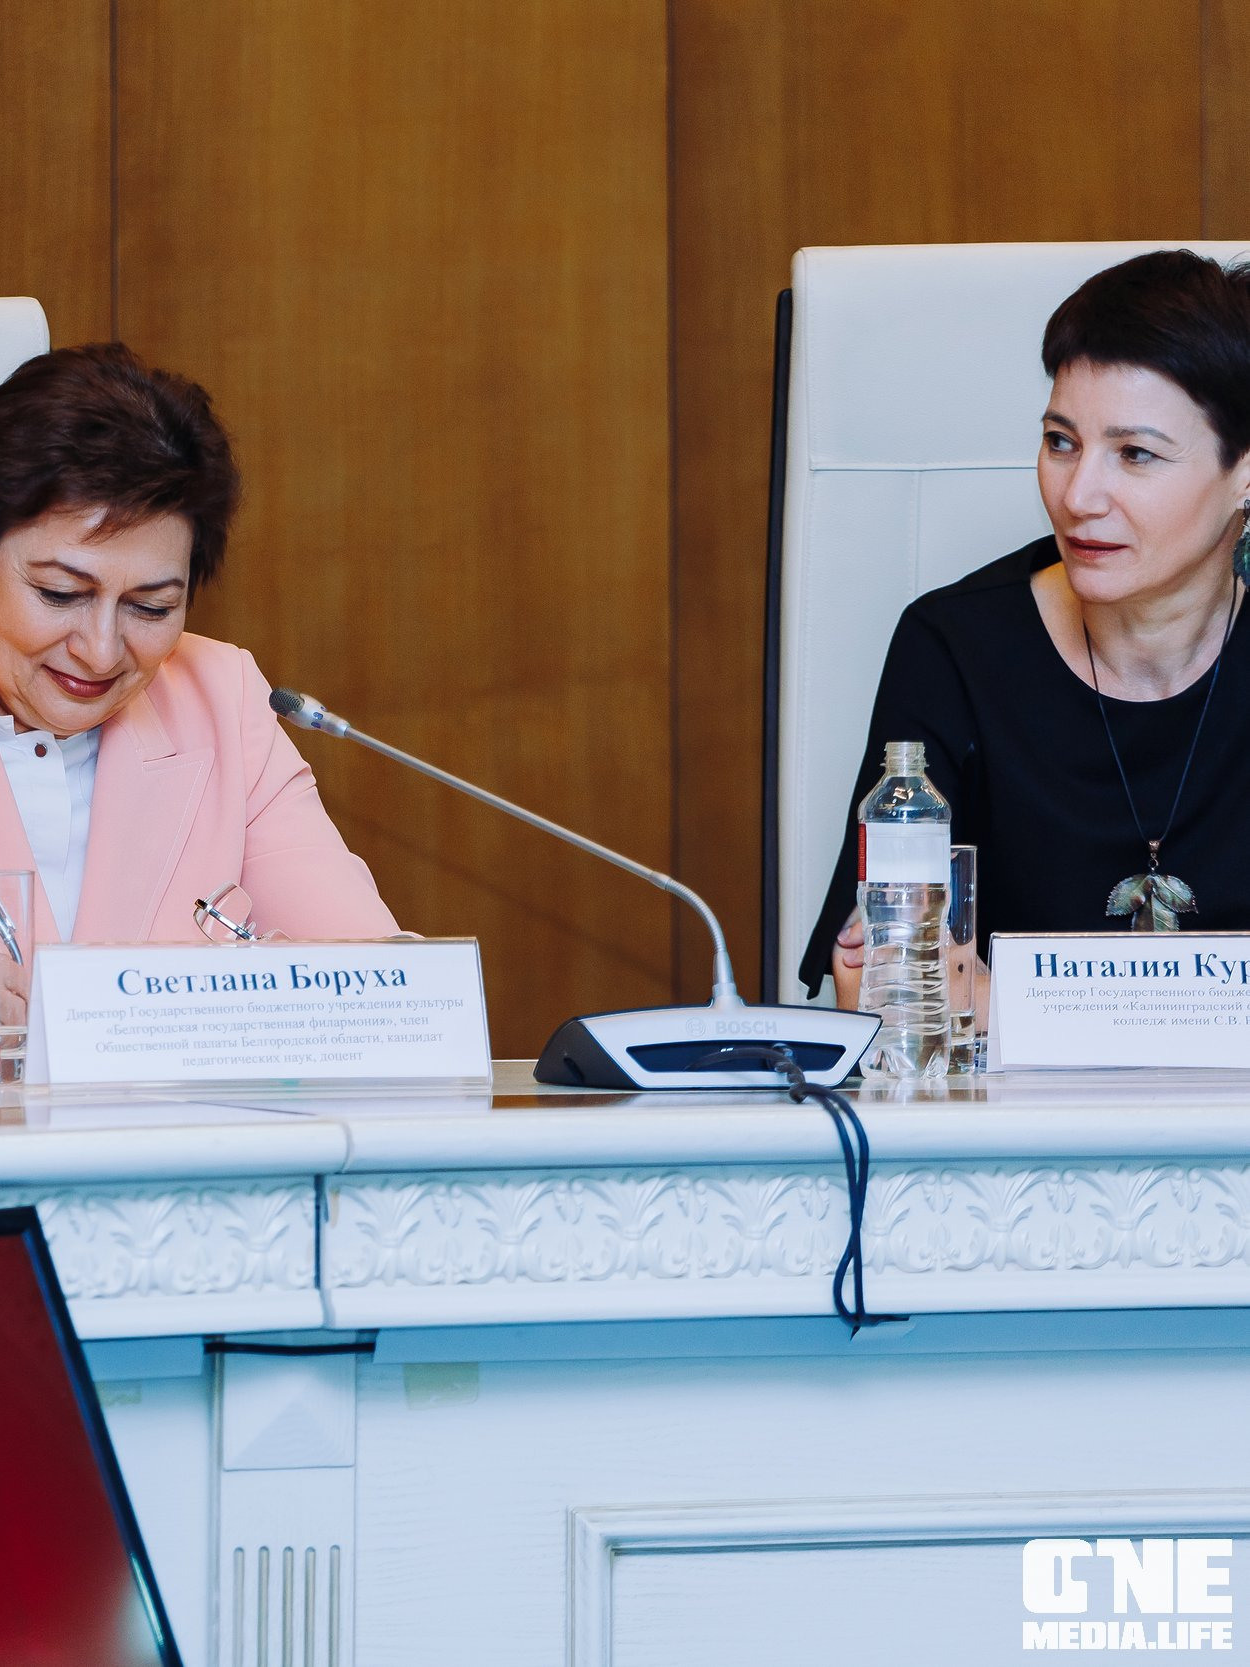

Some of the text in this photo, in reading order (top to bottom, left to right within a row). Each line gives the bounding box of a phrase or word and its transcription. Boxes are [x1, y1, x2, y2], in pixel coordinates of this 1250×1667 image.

[1032, 952, 1181, 979] Наталия
[117, 963, 408, 997] Светлана Боруха
[1026, 987, 1087, 999] Директор
[1090, 987, 1205, 999] Государственного
[66, 998, 464, 1022] Директор Государственного бюджетного учреждения культуры
[1043, 1002, 1119, 1014] учреждения
[1122, 1001, 1243, 1013] «Калининградский
[106, 1016, 429, 1037] «Белгородская государственная филармония», член
[714, 1020, 778, 1035] BOSCH
[1113, 1016, 1166, 1026] колледж
[1171, 1016, 1210, 1026] имени
[95, 1032, 444, 1053] Общественной палаты Белгородской области, кандидат
[182, 1051, 364, 1067] педагогических наук, доцент
